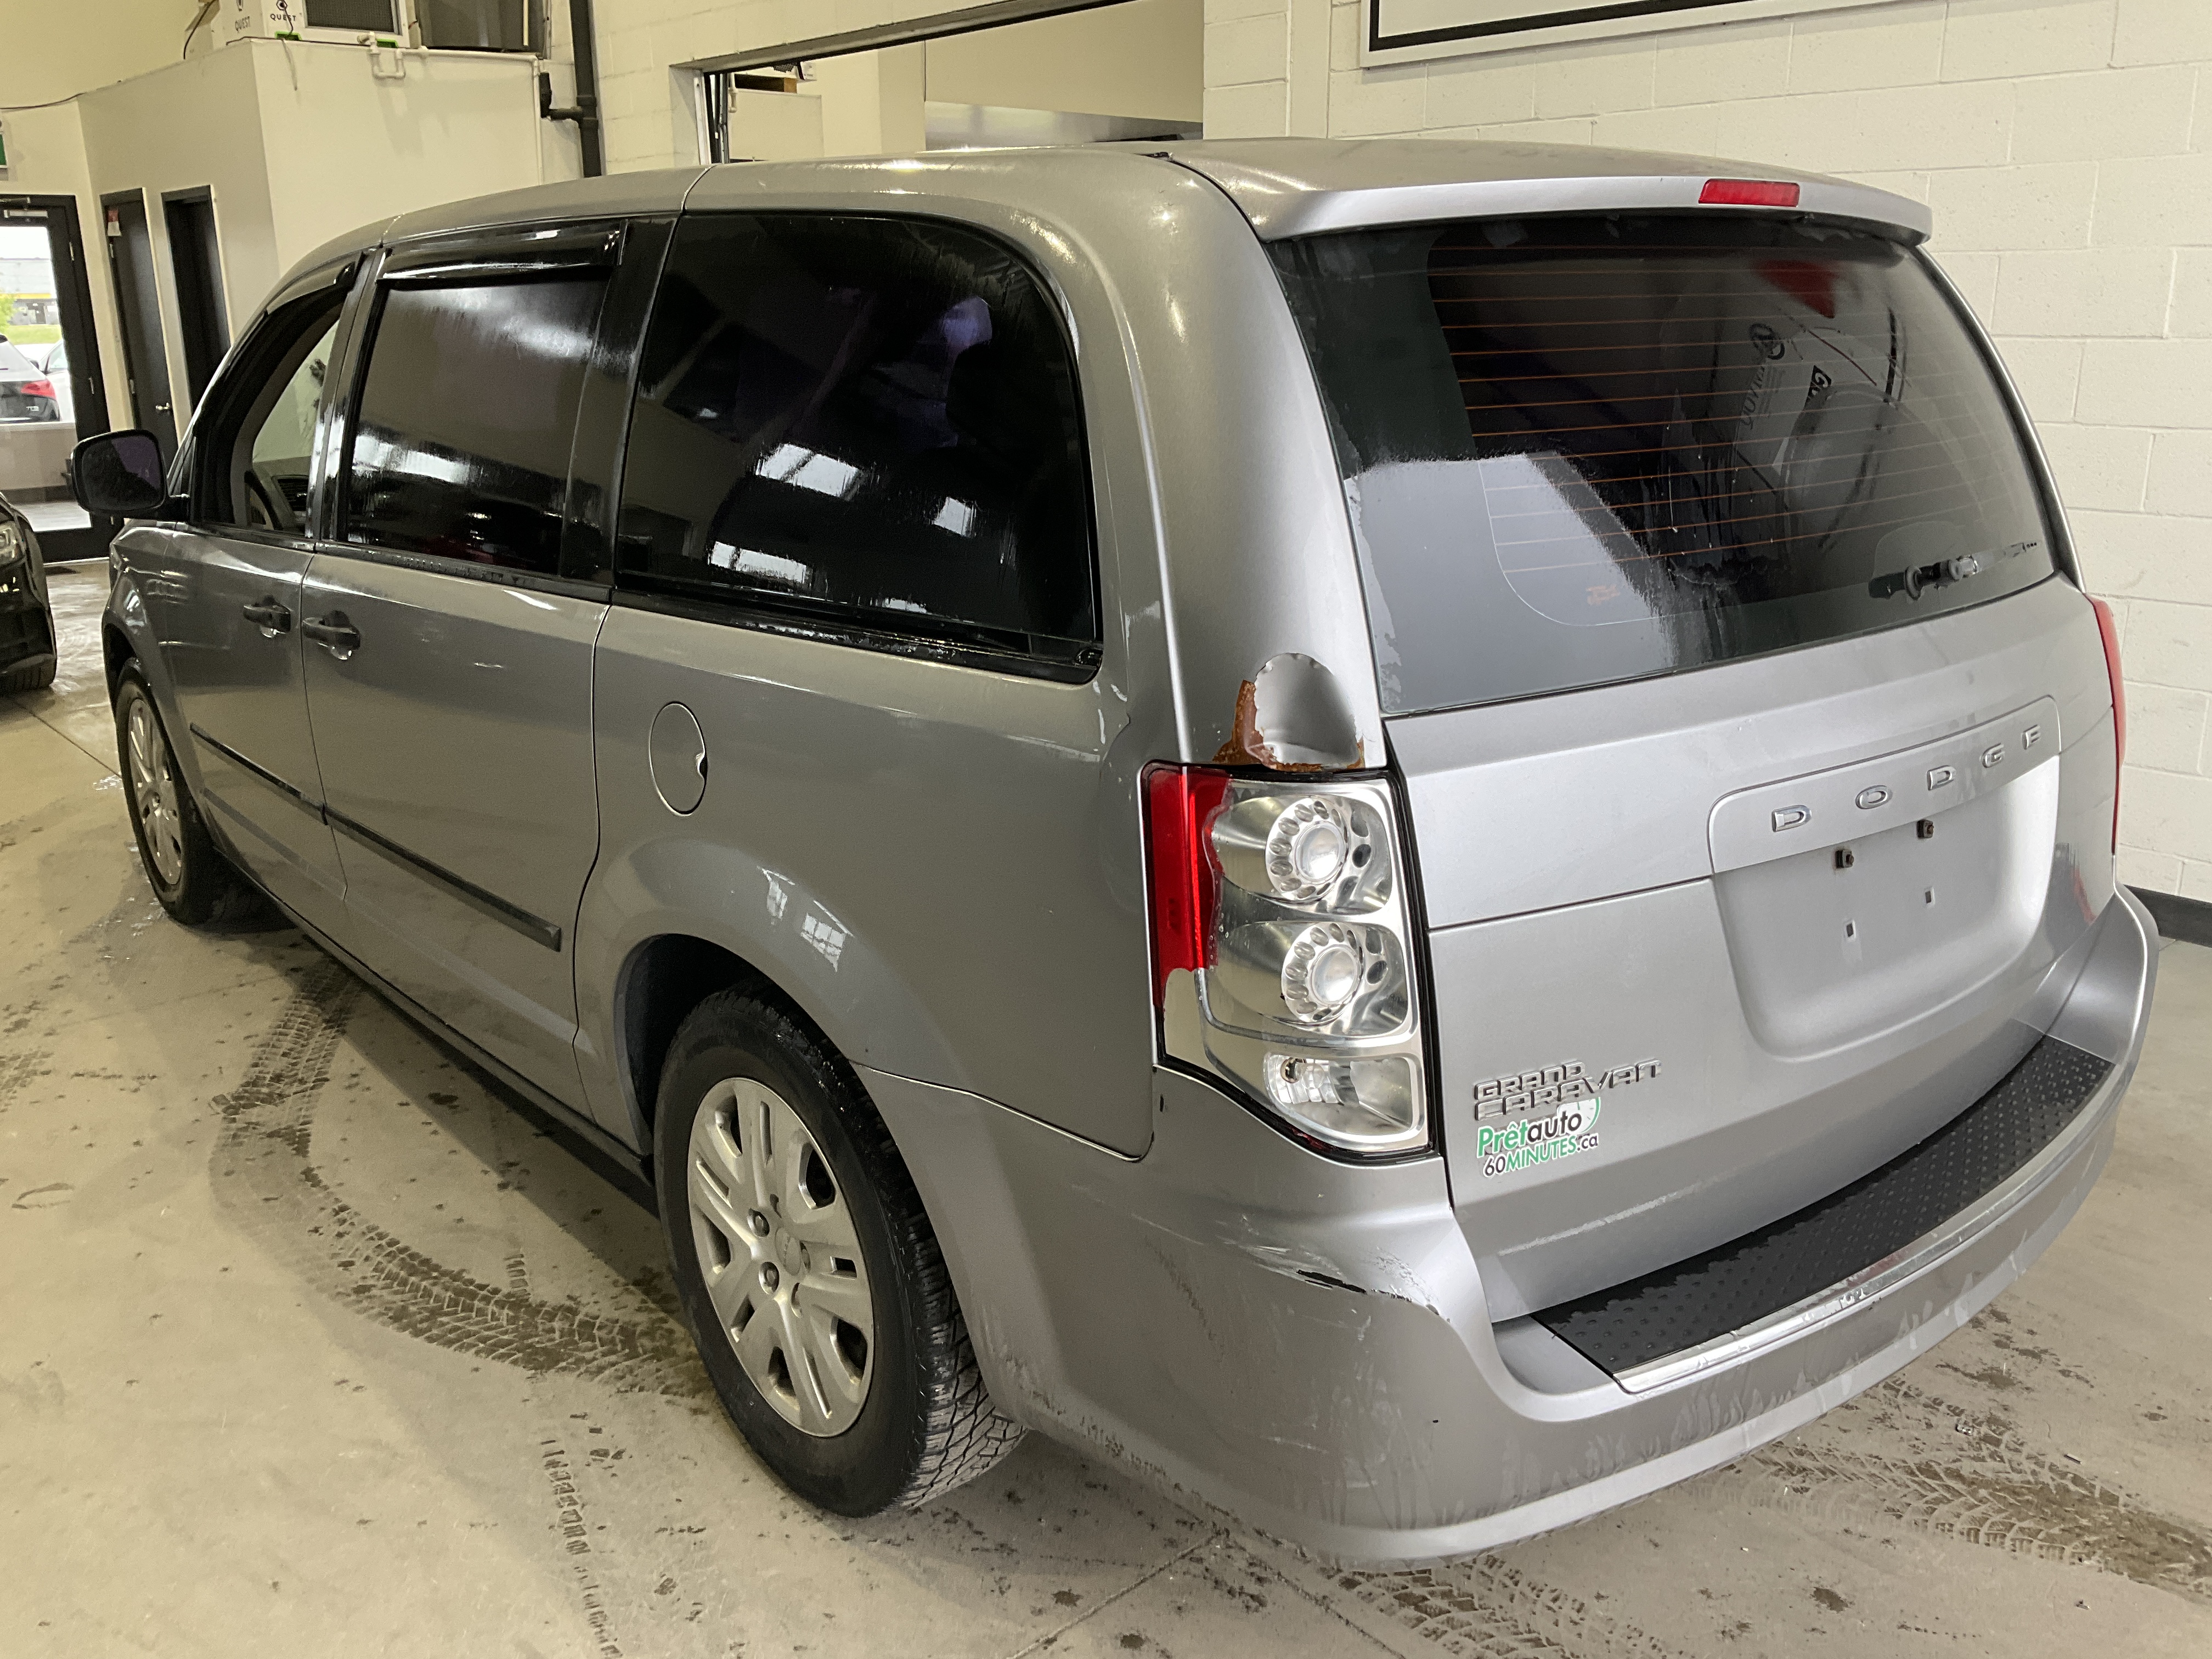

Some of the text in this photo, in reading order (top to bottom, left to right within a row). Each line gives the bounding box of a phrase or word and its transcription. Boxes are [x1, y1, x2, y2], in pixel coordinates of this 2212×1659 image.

[270, 13, 296, 21] QUEST
[1771, 724, 2041, 832] DODGE
[1474, 1060, 1585, 1100] GRAND
[1474, 1059, 1662, 1121] CARAVAN
[1479, 1110, 1582, 1156] Prêtauto
